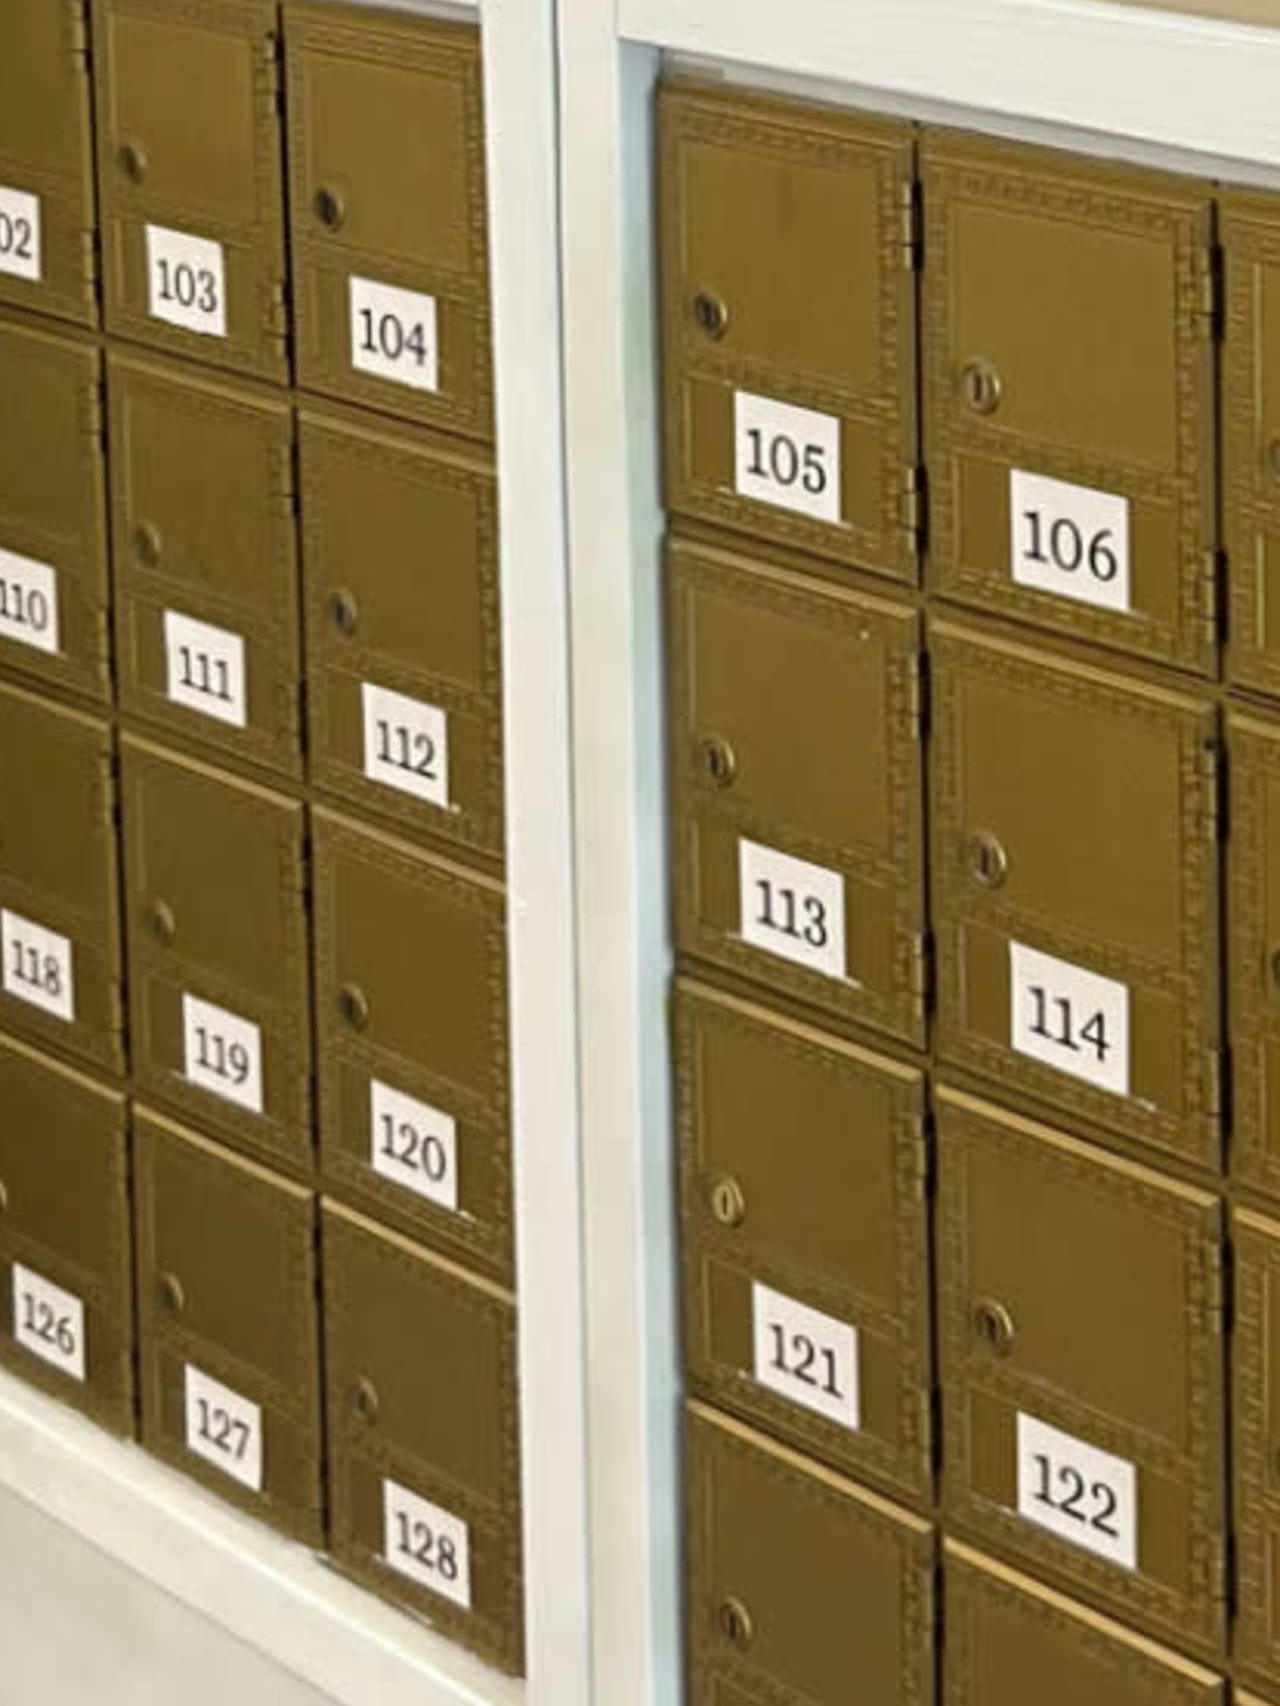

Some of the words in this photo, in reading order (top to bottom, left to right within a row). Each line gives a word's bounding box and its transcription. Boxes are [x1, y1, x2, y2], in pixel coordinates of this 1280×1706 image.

[157, 258, 218, 314] 103
[359, 308, 427, 366] 104
[746, 428, 827, 495] 105
[1023, 511, 1118, 582] 106
[178, 645, 233, 703] 111
[376, 719, 437, 781] 112
[756, 879, 828, 948] 113
[11, 939, 62, 997] 118
[195, 1026, 250, 1085] 119
[1029, 986, 1110, 1062] 114
[381, 1113, 447, 1182] 120
[23, 1292, 75, 1356] 126
[770, 1323, 843, 1399] 121
[197, 1398, 251, 1460] 127
[1034, 1454, 1119, 1538] 122
[396, 1511, 459, 1581] 128
